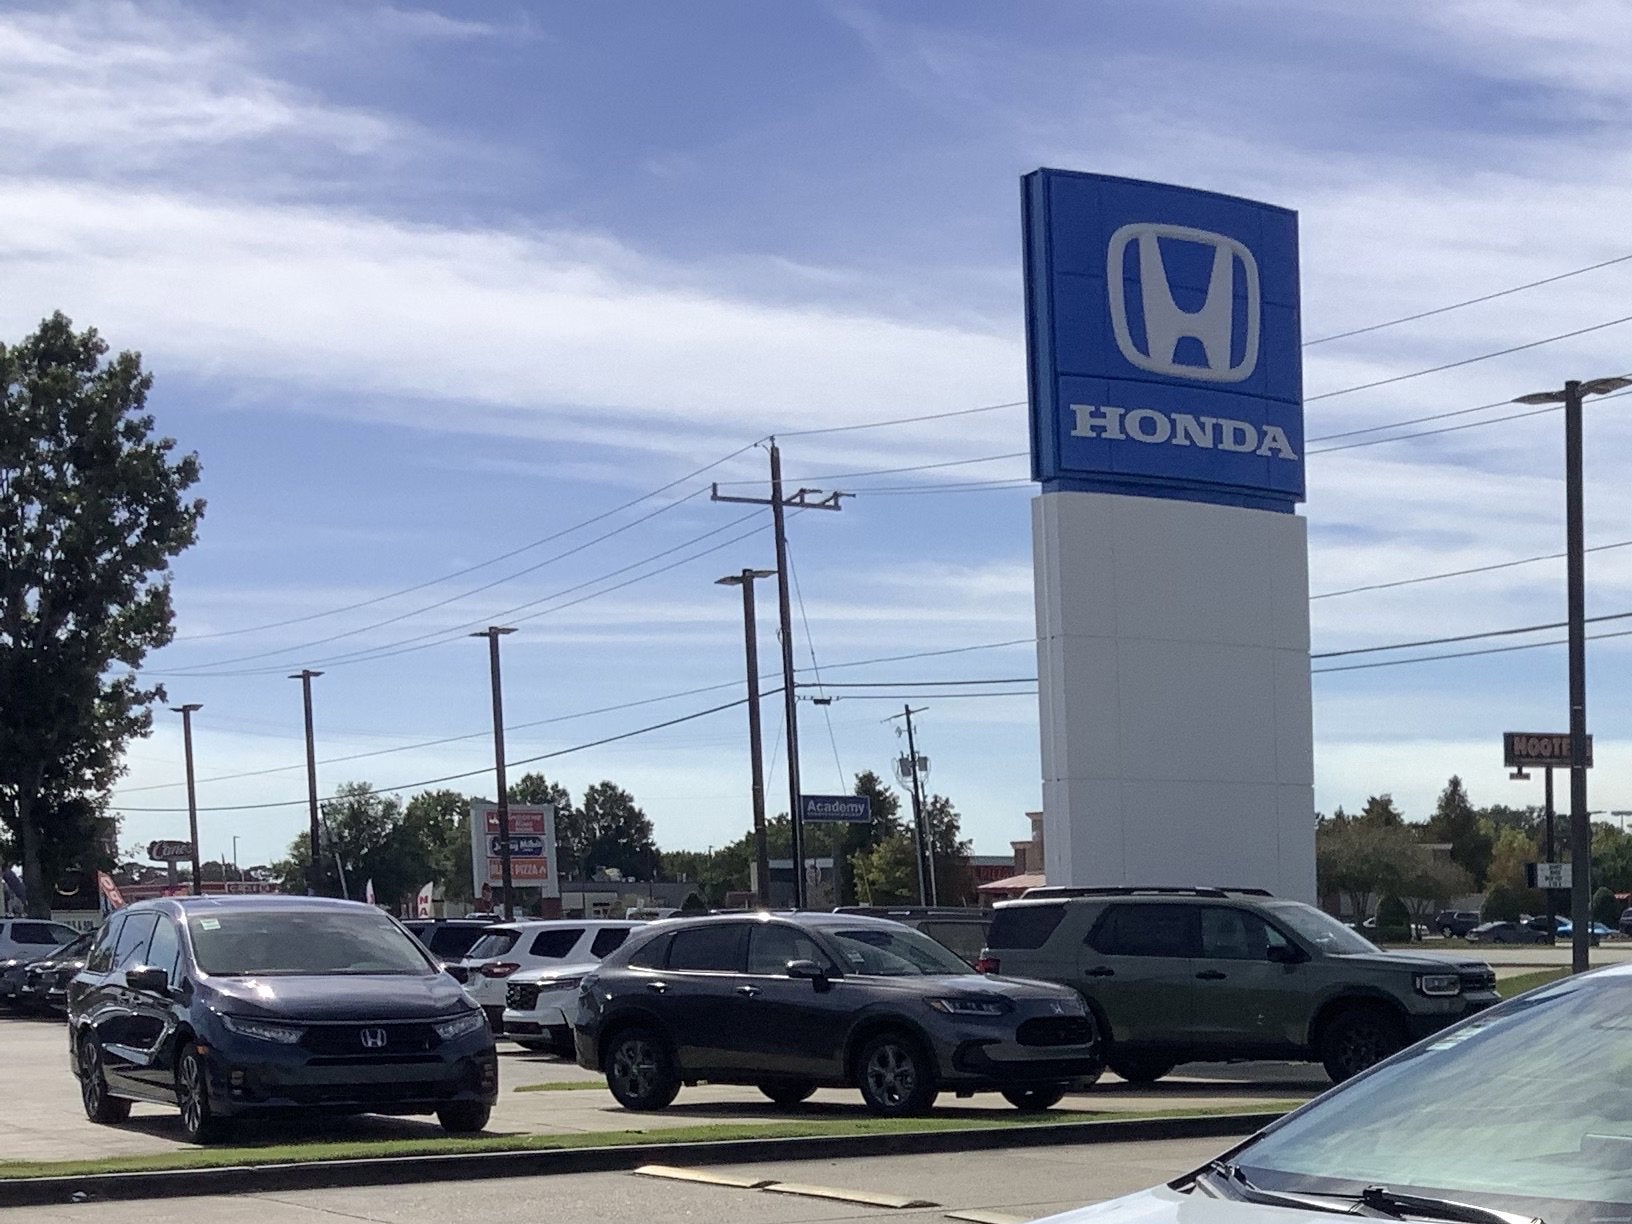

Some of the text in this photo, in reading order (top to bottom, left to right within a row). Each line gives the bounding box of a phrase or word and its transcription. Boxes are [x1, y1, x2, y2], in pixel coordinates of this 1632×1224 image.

[1069, 404, 1298, 461] HONDA
[1514, 736, 1592, 756] HOOTE
[807, 800, 865, 816] Academy
[515, 863, 538, 876] PIZZA
